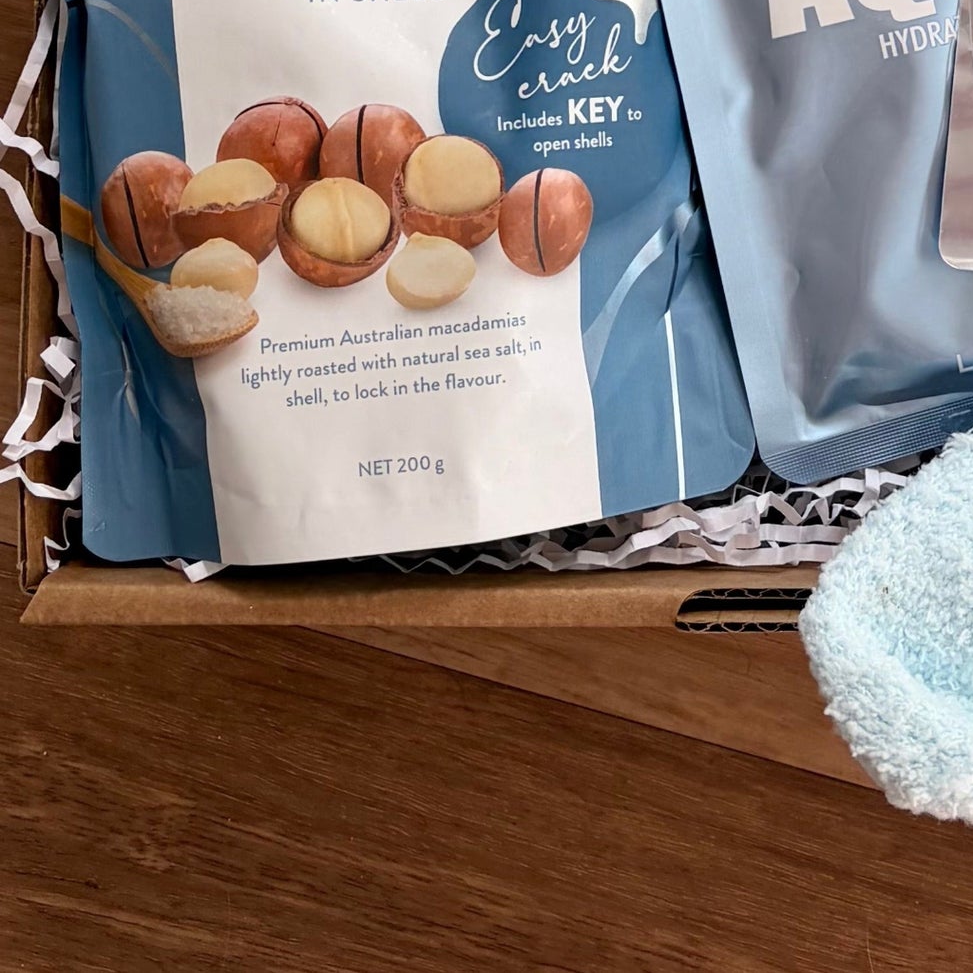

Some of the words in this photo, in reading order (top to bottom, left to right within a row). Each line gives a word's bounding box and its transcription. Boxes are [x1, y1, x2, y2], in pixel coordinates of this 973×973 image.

[878, 15, 960, 60] HYDRA
[518, 23, 633, 99] crack
[497, 110, 563, 132] Includes
[568, 96, 625, 125] KEY
[627, 108, 643, 121] to
[533, 138, 571, 158] open
[574, 131, 613, 149] shells
[260, 334, 335, 355] Premium
[339, 324, 423, 346] Australian
[428, 312, 527, 338] macadamias
[241, 367, 293, 390] lightly
[297, 356, 357, 378] roasted
[361, 352, 397, 371] with
[402, 346, 460, 368] natural
[464, 345, 491, 361] sea
[495, 338, 527, 358] salt,
[529, 336, 542, 353] in
[286, 388, 329, 408] shell,
[333, 387, 350, 403] to
[355, 381, 389, 400] lock
[393, 379, 408, 396] in
[413, 376, 441, 394] the
[445, 372, 507, 391] flavour.
[358, 459, 393, 477] NET
[397, 455, 431, 474] 200
[434, 458, 445, 475] g
